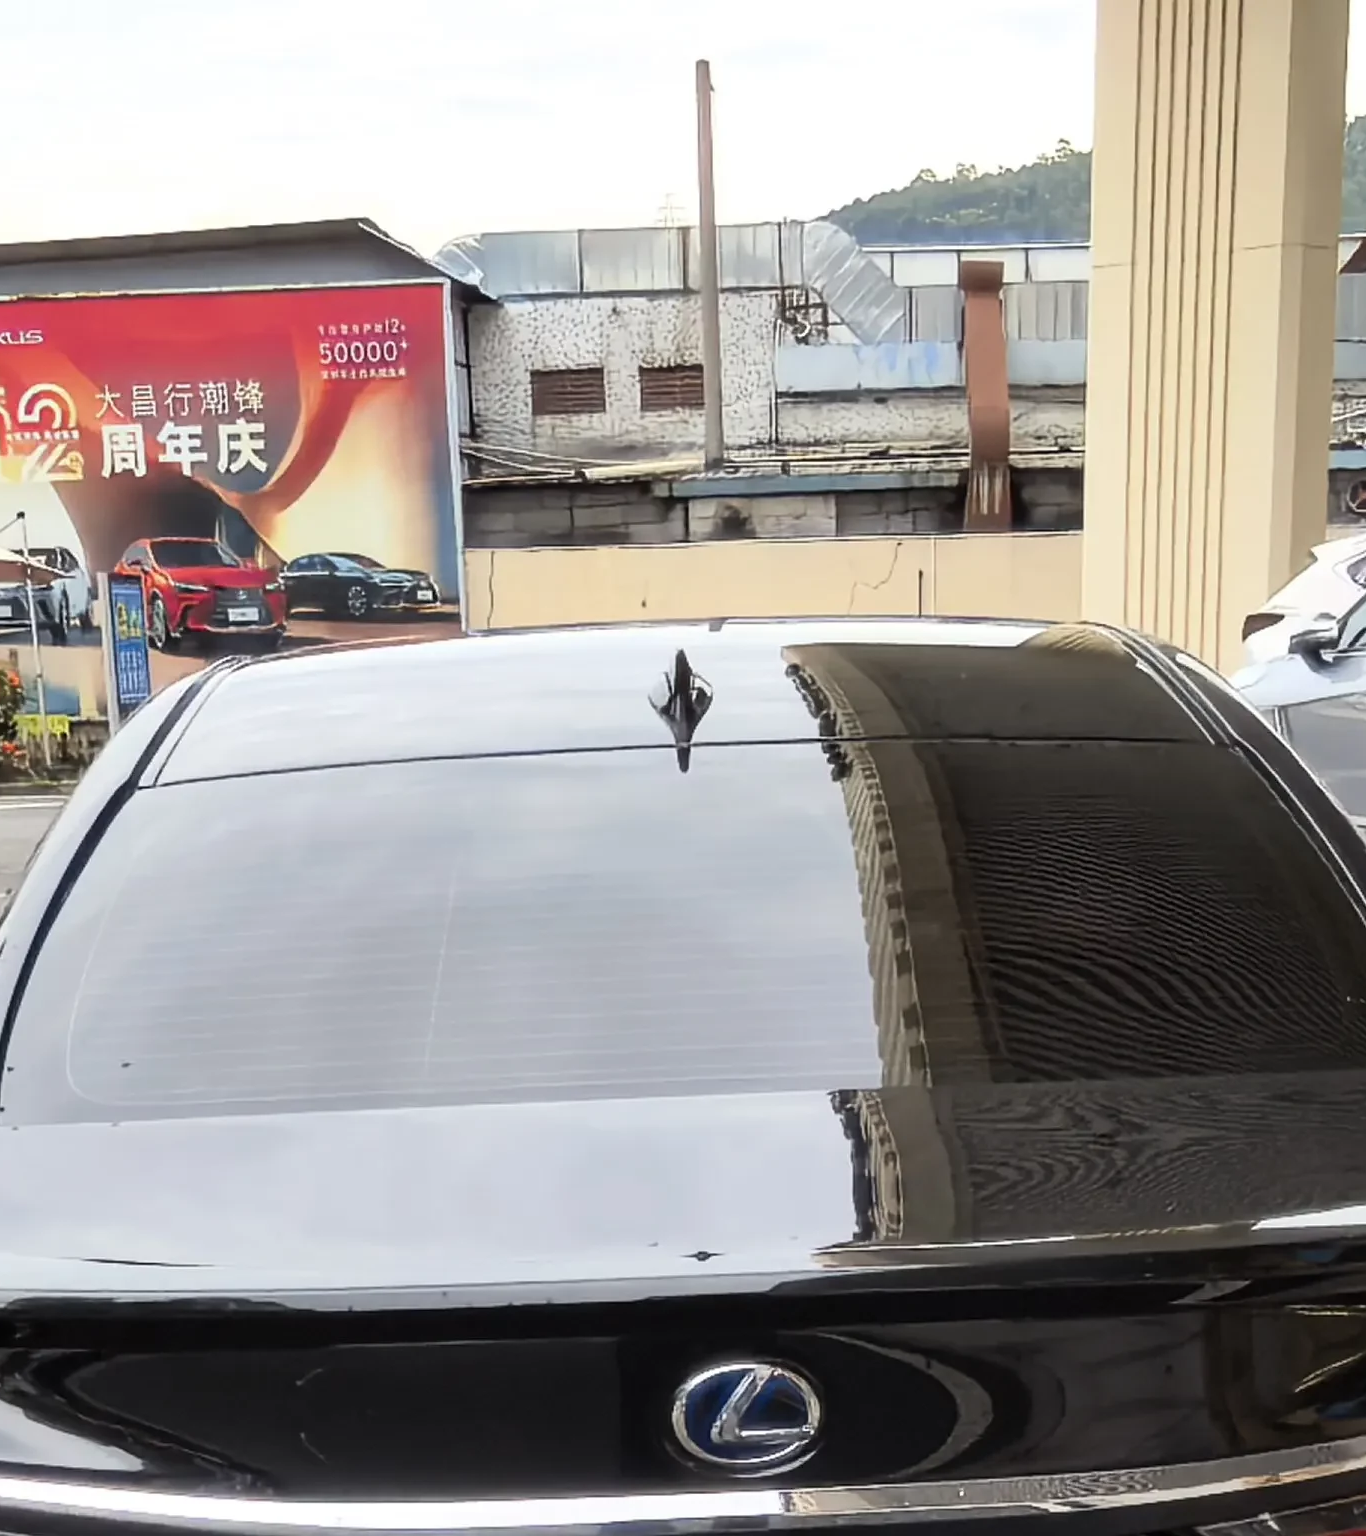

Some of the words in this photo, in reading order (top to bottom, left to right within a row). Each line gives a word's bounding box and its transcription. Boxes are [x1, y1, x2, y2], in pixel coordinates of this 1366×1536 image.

[95, 378, 264, 419] 大昌行潮锋
[100, 418, 268, 479] 周年庆
